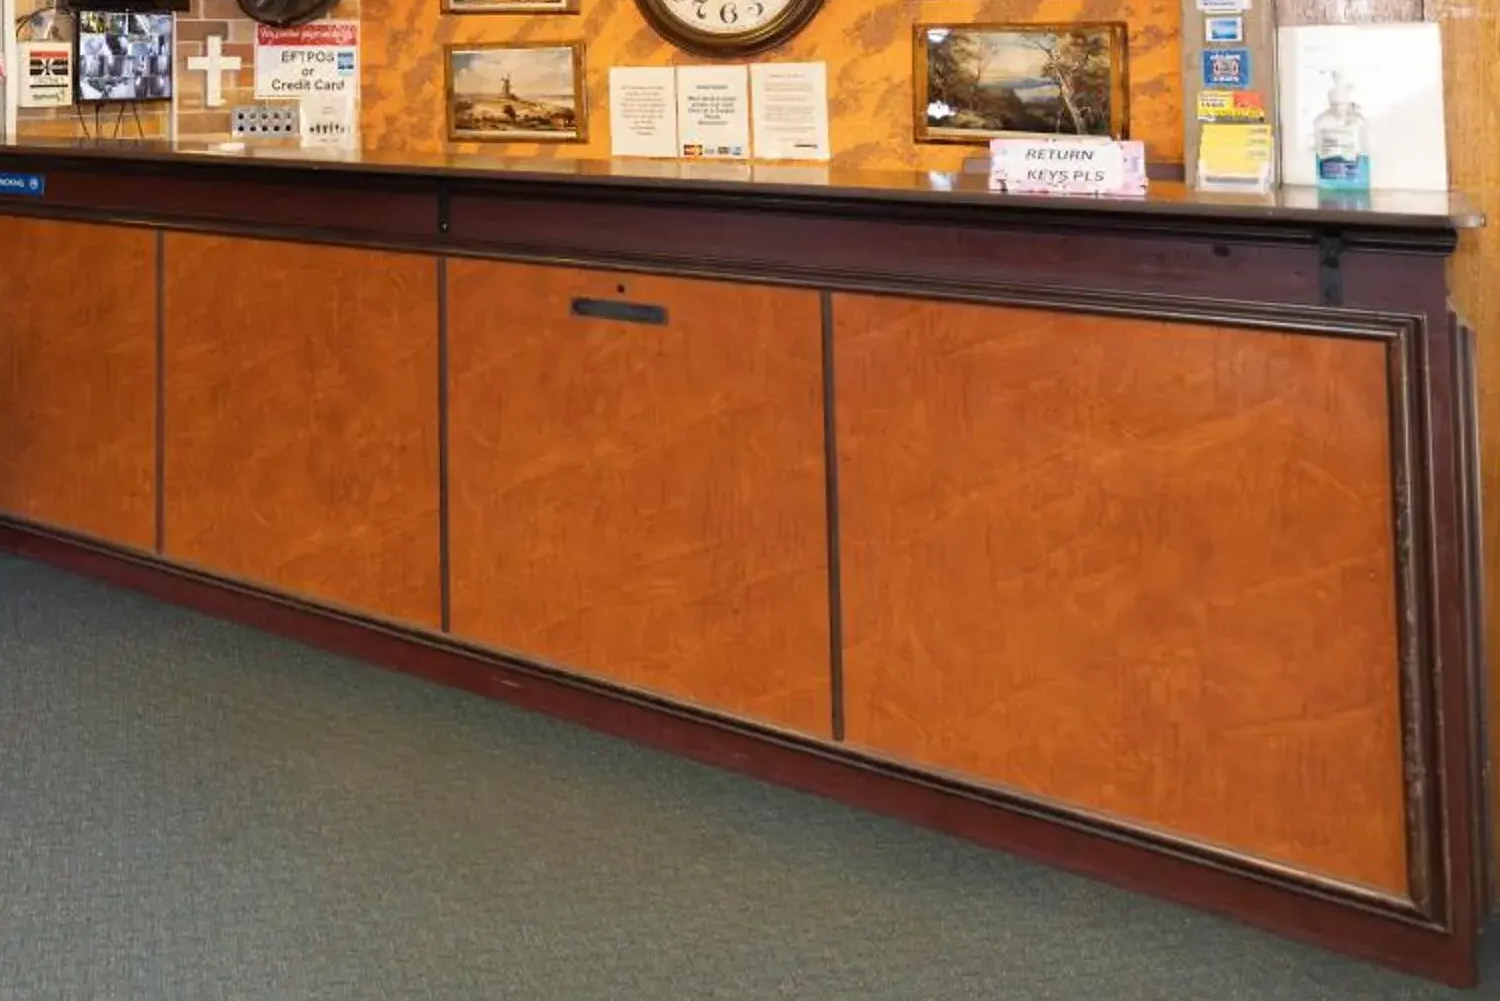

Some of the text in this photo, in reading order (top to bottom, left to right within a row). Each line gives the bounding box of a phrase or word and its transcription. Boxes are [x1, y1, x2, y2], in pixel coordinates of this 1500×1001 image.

[719, 2, 739, 24] 6
[281, 50, 335, 63] EFTPOS
[301, 67, 315, 76] or
[271, 78, 345, 91] Credit Card
[1025, 149, 1095, 161] RETURN
[1027, 170, 1106, 182] KEYS PLS
